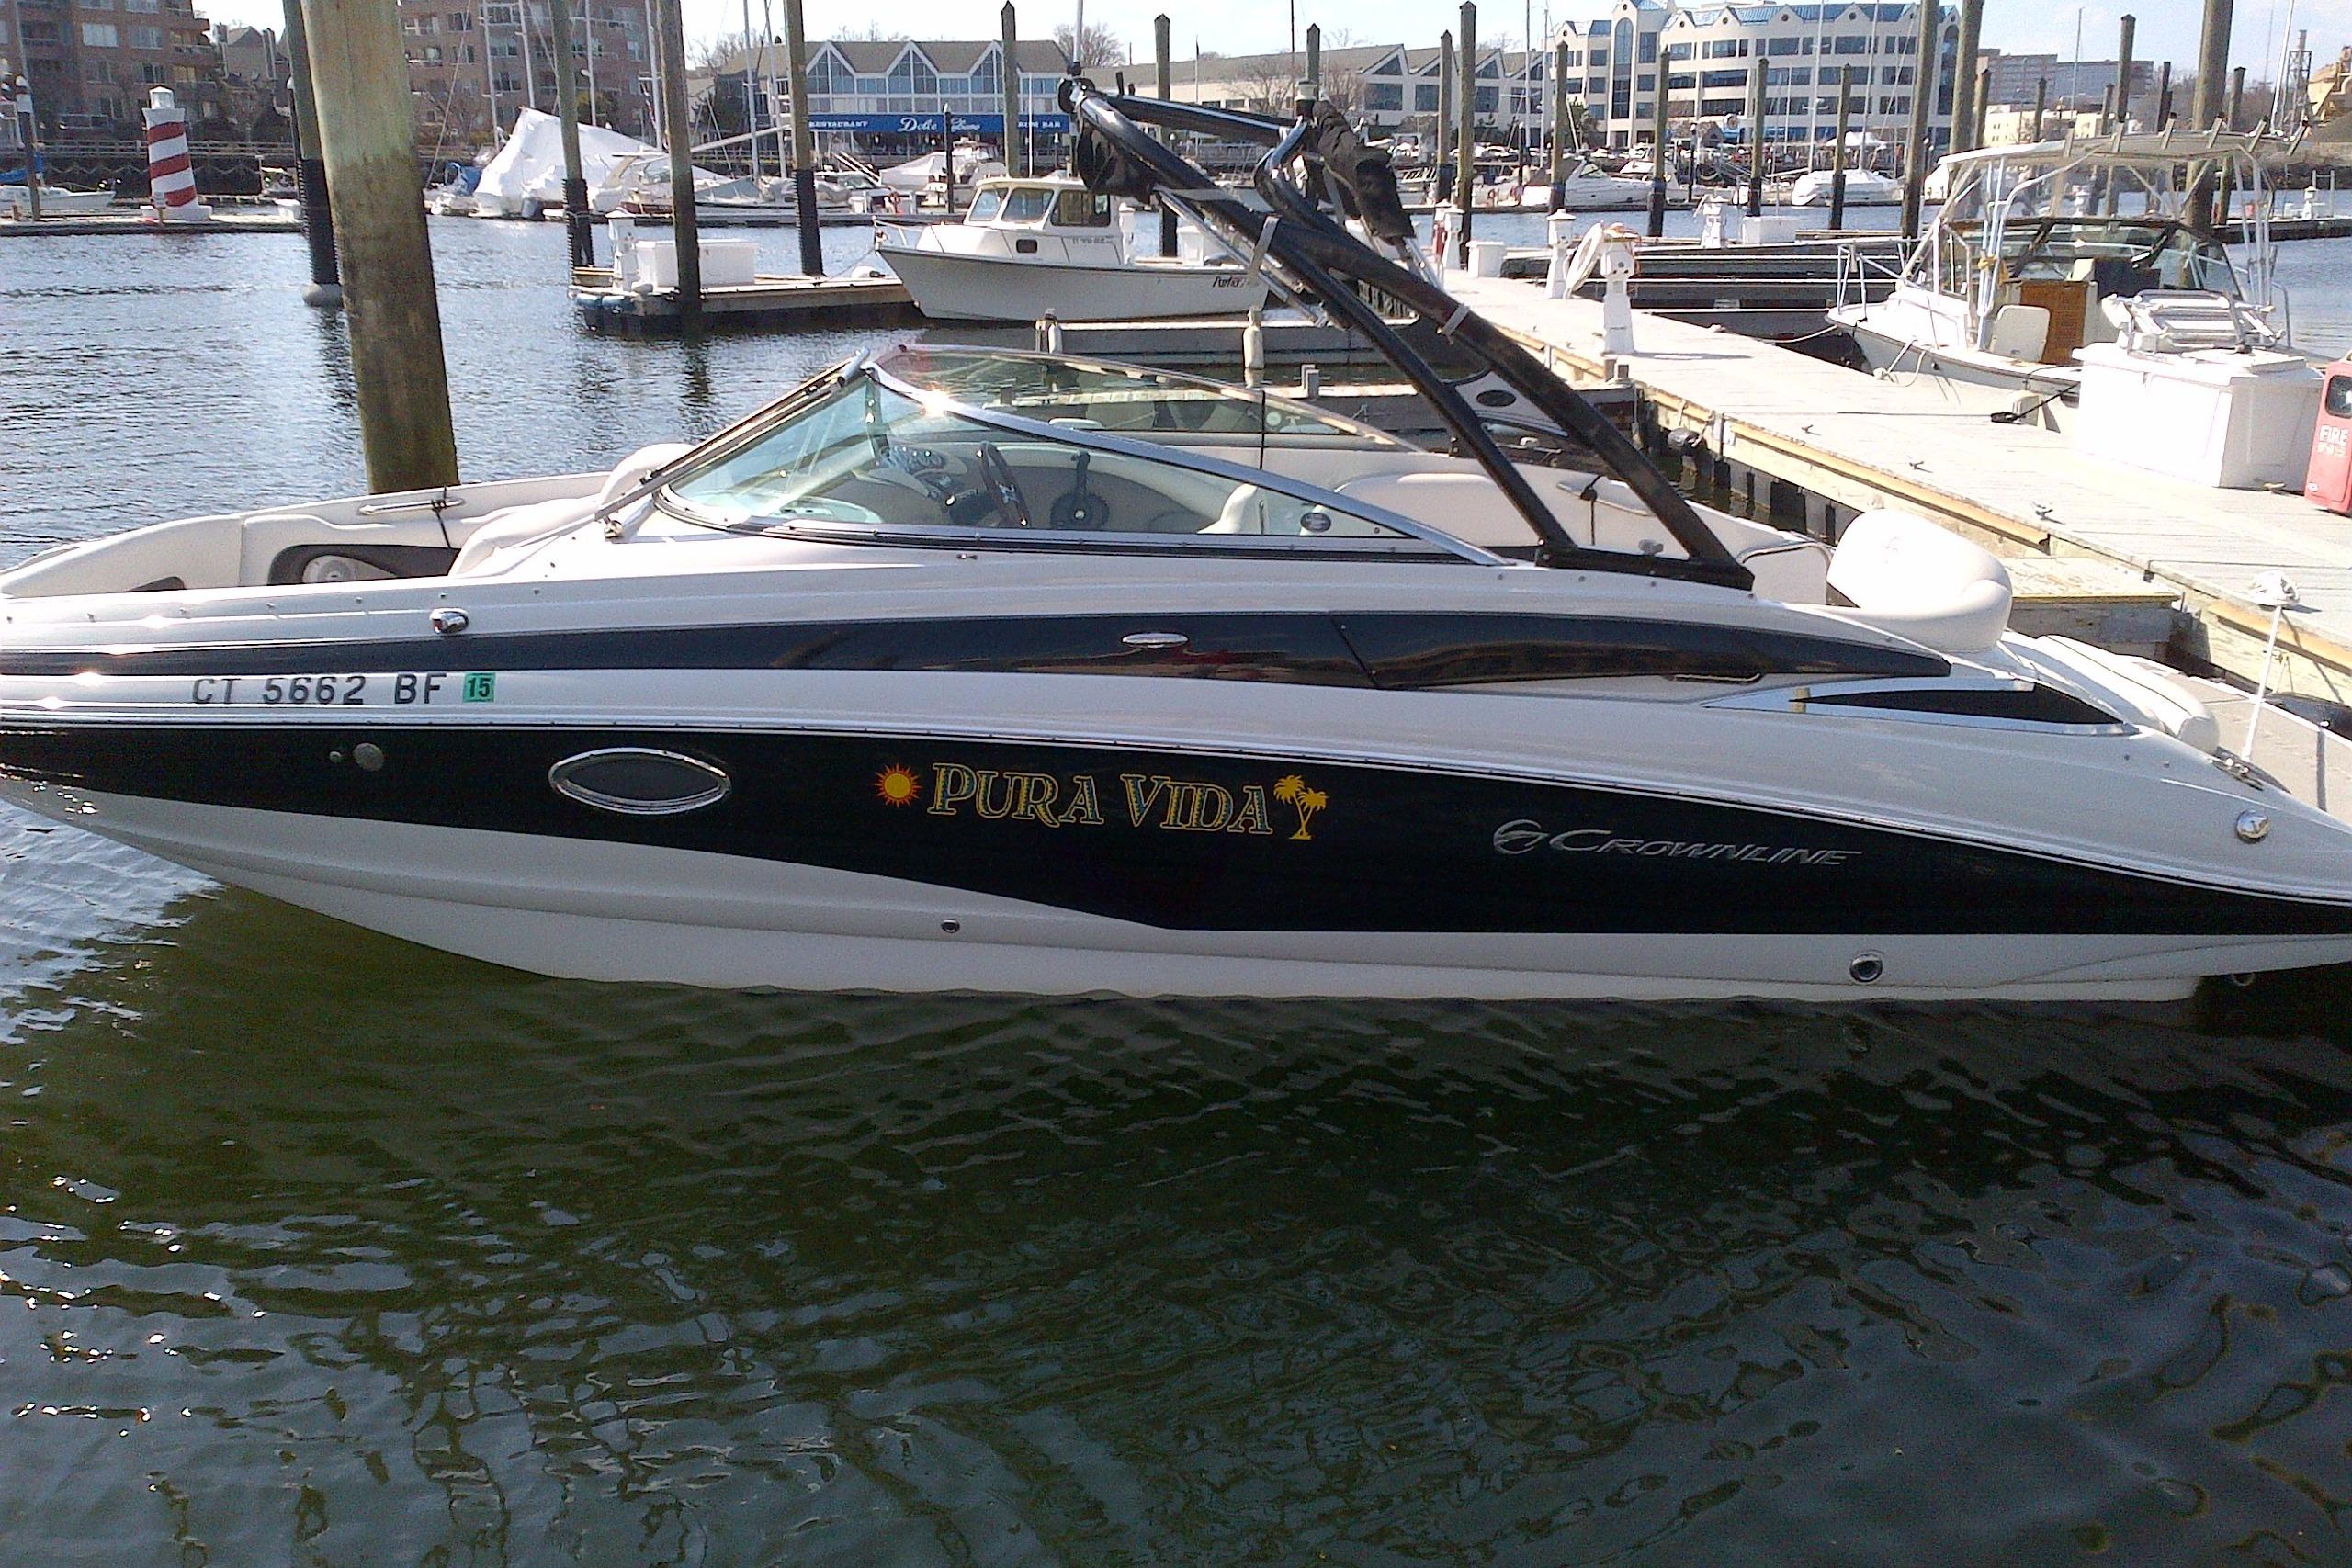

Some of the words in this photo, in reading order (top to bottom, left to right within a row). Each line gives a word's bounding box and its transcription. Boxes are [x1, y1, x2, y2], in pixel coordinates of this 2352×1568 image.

[2319, 424, 2348, 446] FIRE
[192, 677, 241, 704] CT
[262, 675, 366, 705] 5662
[394, 672, 447, 705] BF
[467, 677, 491, 698] 15
[927, 762, 1104, 828] PURA
[1120, 773, 1273, 834] VIDA
[1549, 829, 1863, 865] CROWNLINE
